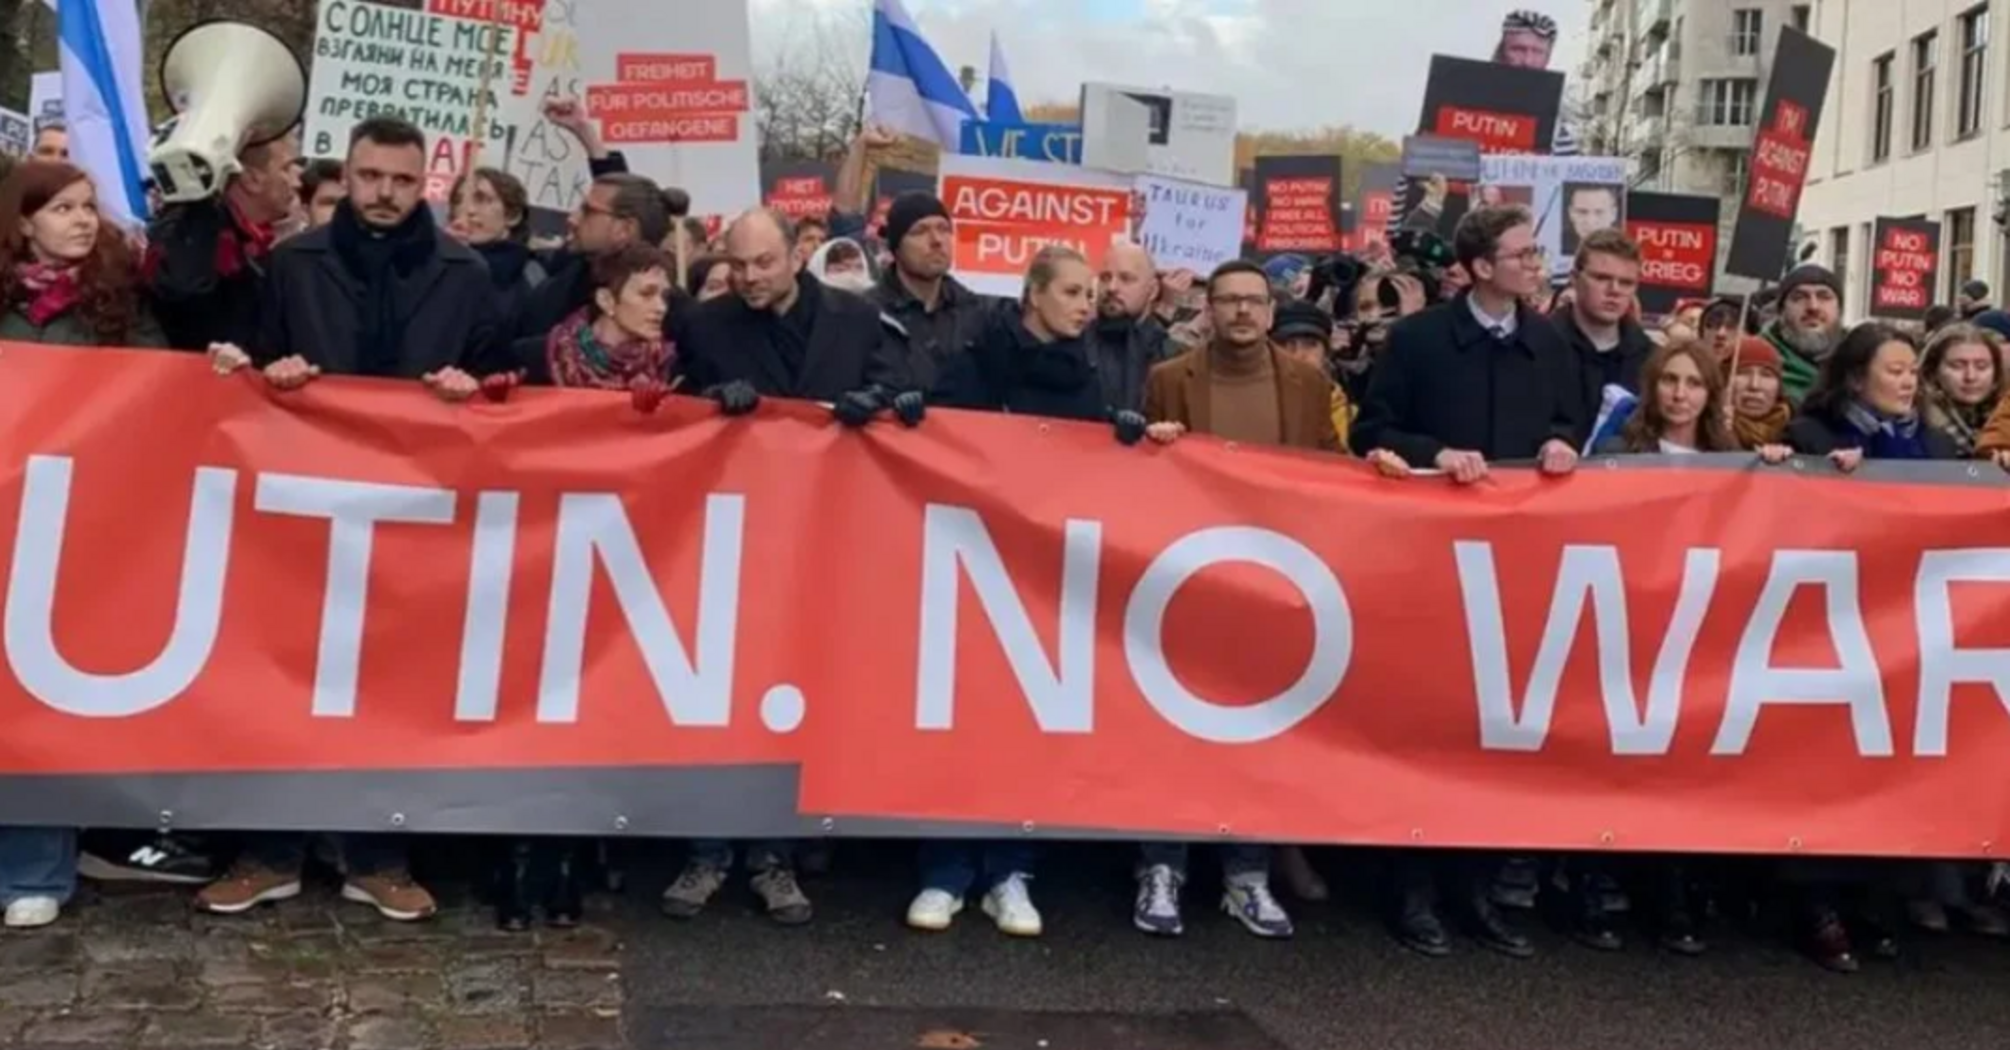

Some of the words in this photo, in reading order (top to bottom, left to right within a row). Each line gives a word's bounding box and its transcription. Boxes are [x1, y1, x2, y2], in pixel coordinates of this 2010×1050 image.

[438, 0, 539, 24] ПУТНУ
[326, 2, 442, 47] СОЛНЦЕ
[317, 38, 403, 66] ВЗГЛЯНИ
[411, 47, 438, 72] НА
[625, 62, 708, 79] FREIHEIT
[341, 71, 392, 96] МОЯ
[590, 90, 628, 111] FÜR
[633, 89, 744, 109] POLITISCHE
[321, 96, 504, 139] ПРЕВРТИЛАЬ
[610, 119, 730, 138] GEFANGENE
[1452, 111, 1518, 138] PUTIN
[315, 132, 332, 153] В
[1480, 158, 1537, 180] UTIN
[1149, 183, 1230, 212] TAURUS
[1269, 181, 1288, 192] NO
[953, 186, 1117, 225] AGAINST
[1175, 212, 1206, 230] for
[978, 233, 1086, 265] PUT
[1143, 233, 1226, 263] Ukraine
[1637, 227, 1702, 250] PUTIN
[1893, 232, 1921, 251] NO
[1641, 259, 1705, 282] KRIEG
[1881, 250, 1930, 270] PUTIN
[1892, 269, 1918, 287] NO
[1880, 286, 1920, 305] WAR
[5, 455, 804, 731] UTIN.
[916, 505, 1351, 743] NO
[1455, 542, 2010, 761] WAR
